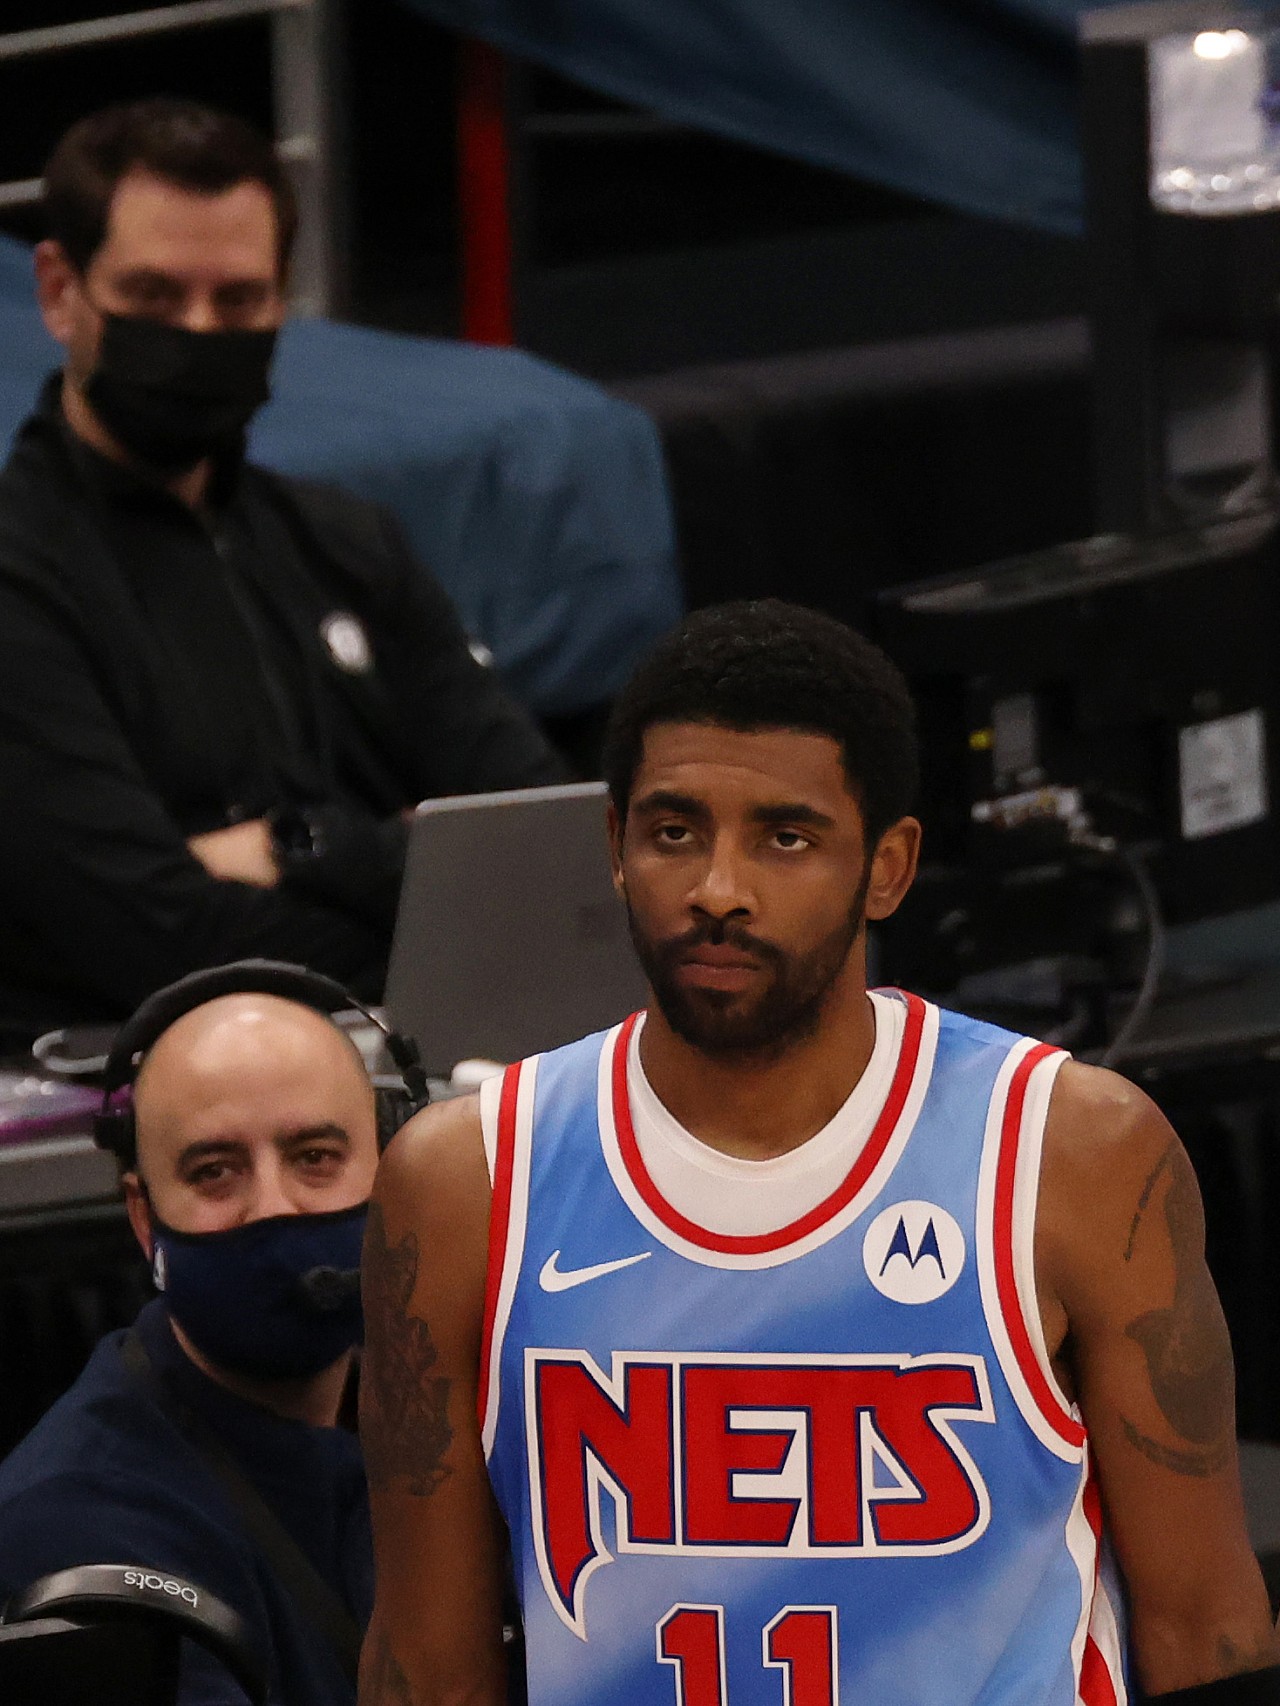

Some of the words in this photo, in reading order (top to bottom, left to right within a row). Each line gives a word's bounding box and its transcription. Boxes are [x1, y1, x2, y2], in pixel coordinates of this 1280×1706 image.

[524, 1347, 996, 1642] NETS
[124, 1571, 198, 1608] beats
[656, 1602, 838, 1706] 11
